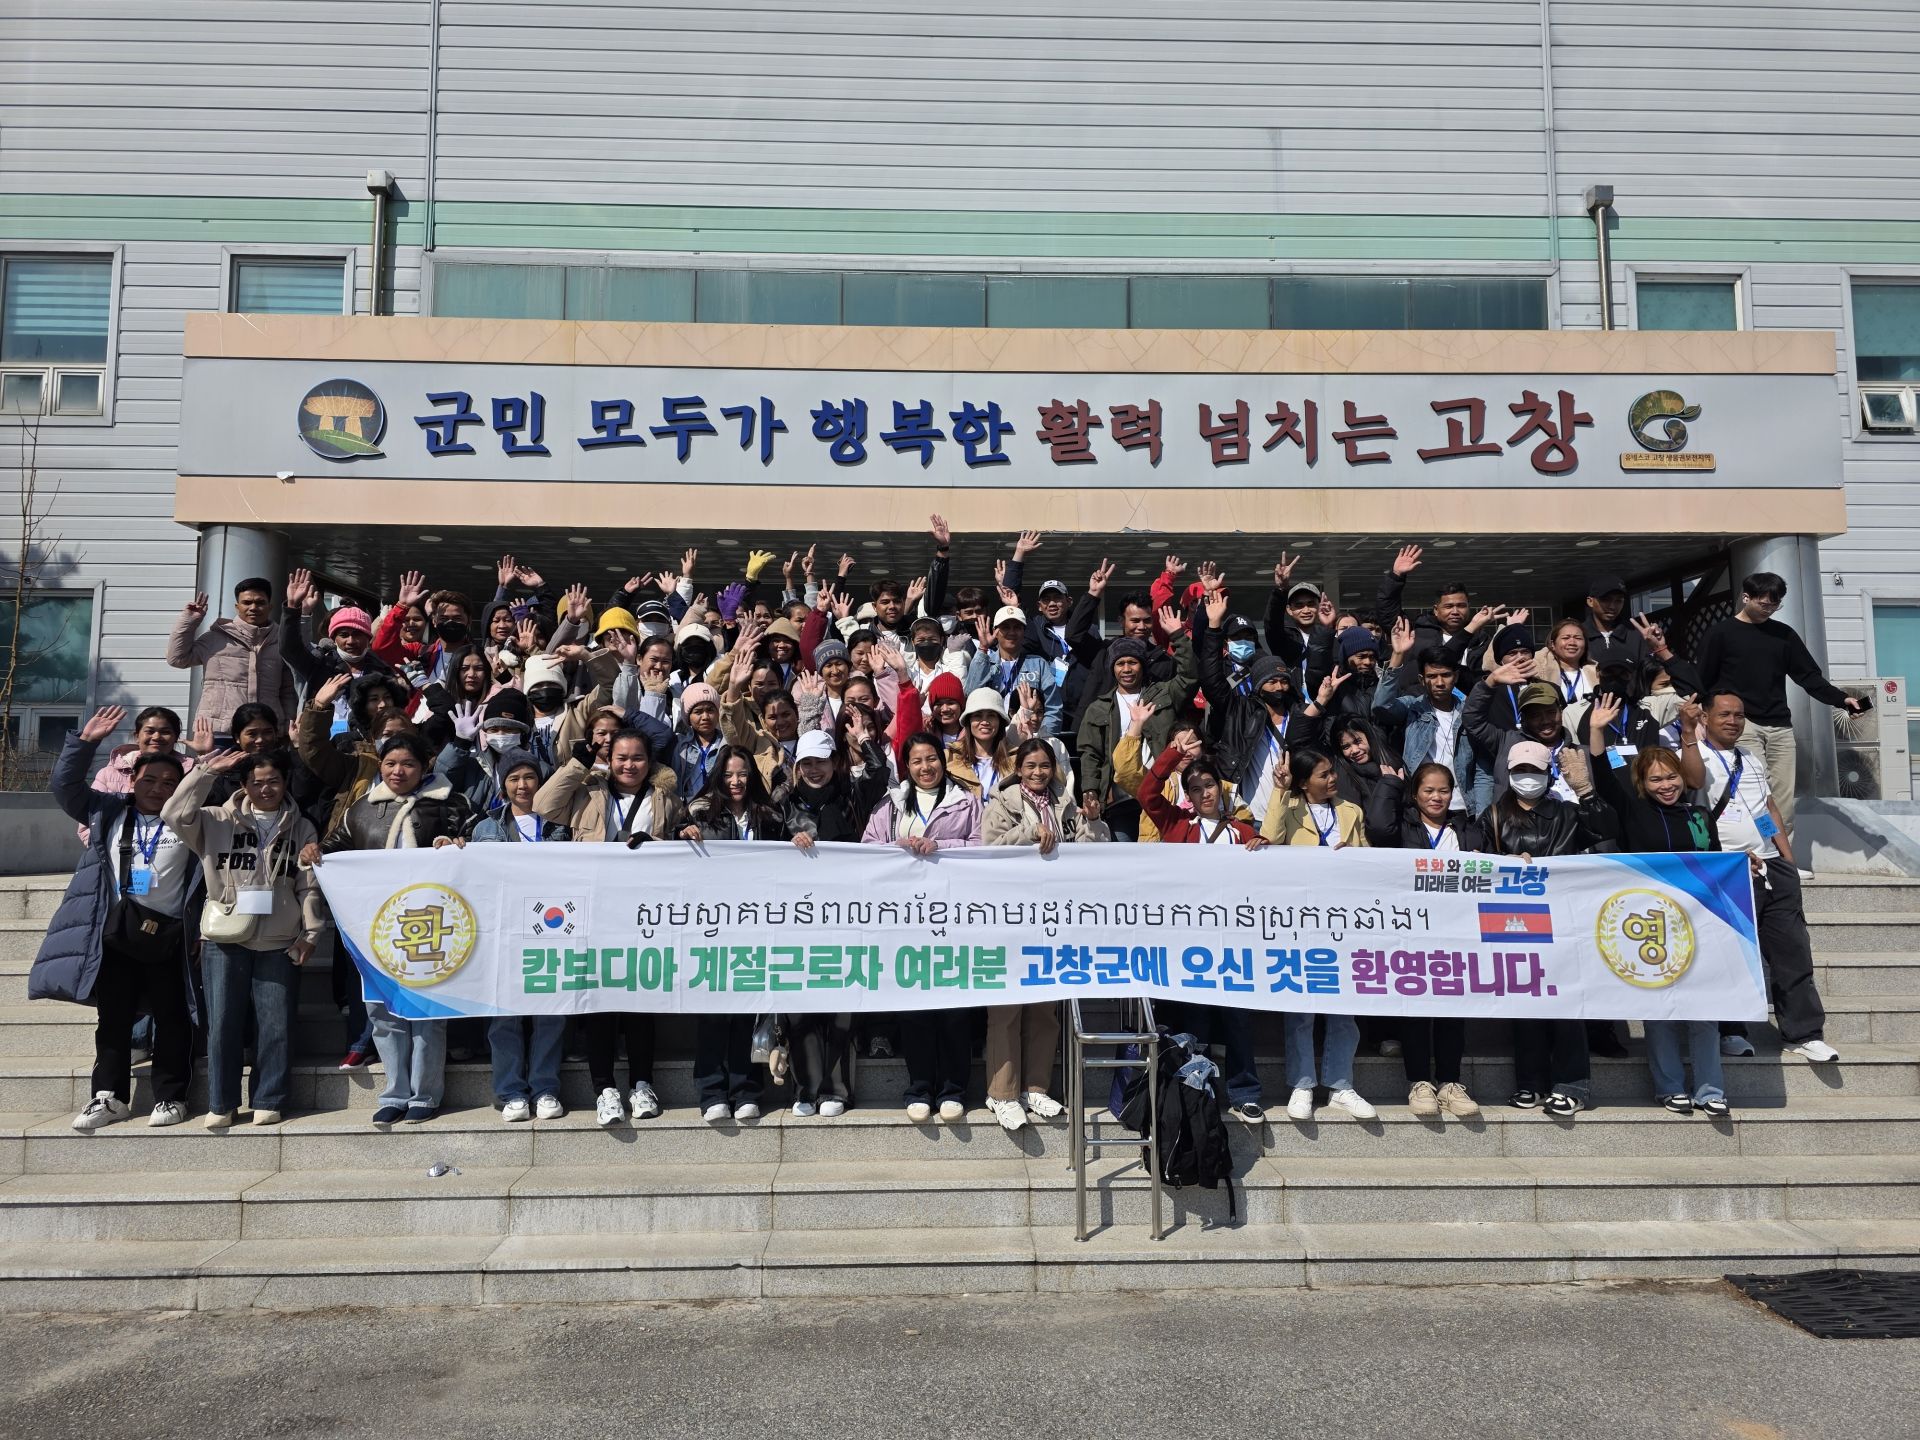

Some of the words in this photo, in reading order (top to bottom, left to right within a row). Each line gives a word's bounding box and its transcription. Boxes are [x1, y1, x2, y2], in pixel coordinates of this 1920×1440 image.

[415, 391, 550, 456] 군민
[578, 395, 787, 464] 모두가
[810, 398, 1014, 467] 행복한
[1037, 398, 1161, 464] 활력
[1199, 399, 1397, 465] 넘치는
[1416, 389, 1593, 473] 고창
[1886, 695, 1897, 703] LG
[216, 852, 257, 871] FOR
[1414, 858, 1461, 874] 변화와
[1464, 859, 1494, 874] 성장
[1414, 874, 1459, 894] 미래를
[1462, 875, 1492, 894] 여는
[1495, 865, 1550, 897] 고창
[392, 904, 454, 962] 환
[1622, 908, 1668, 966] 영
[522, 946, 678, 994] 캄보디아
[688, 945, 884, 992] 계절근로자
[895, 945, 1007, 990] 여러분
[1020, 944, 1169, 988] 고창군에
[1181, 945, 1256, 992] 오신
[1265, 947, 1341, 994] 것을
[1351, 948, 1558, 997] 환영합니다.
